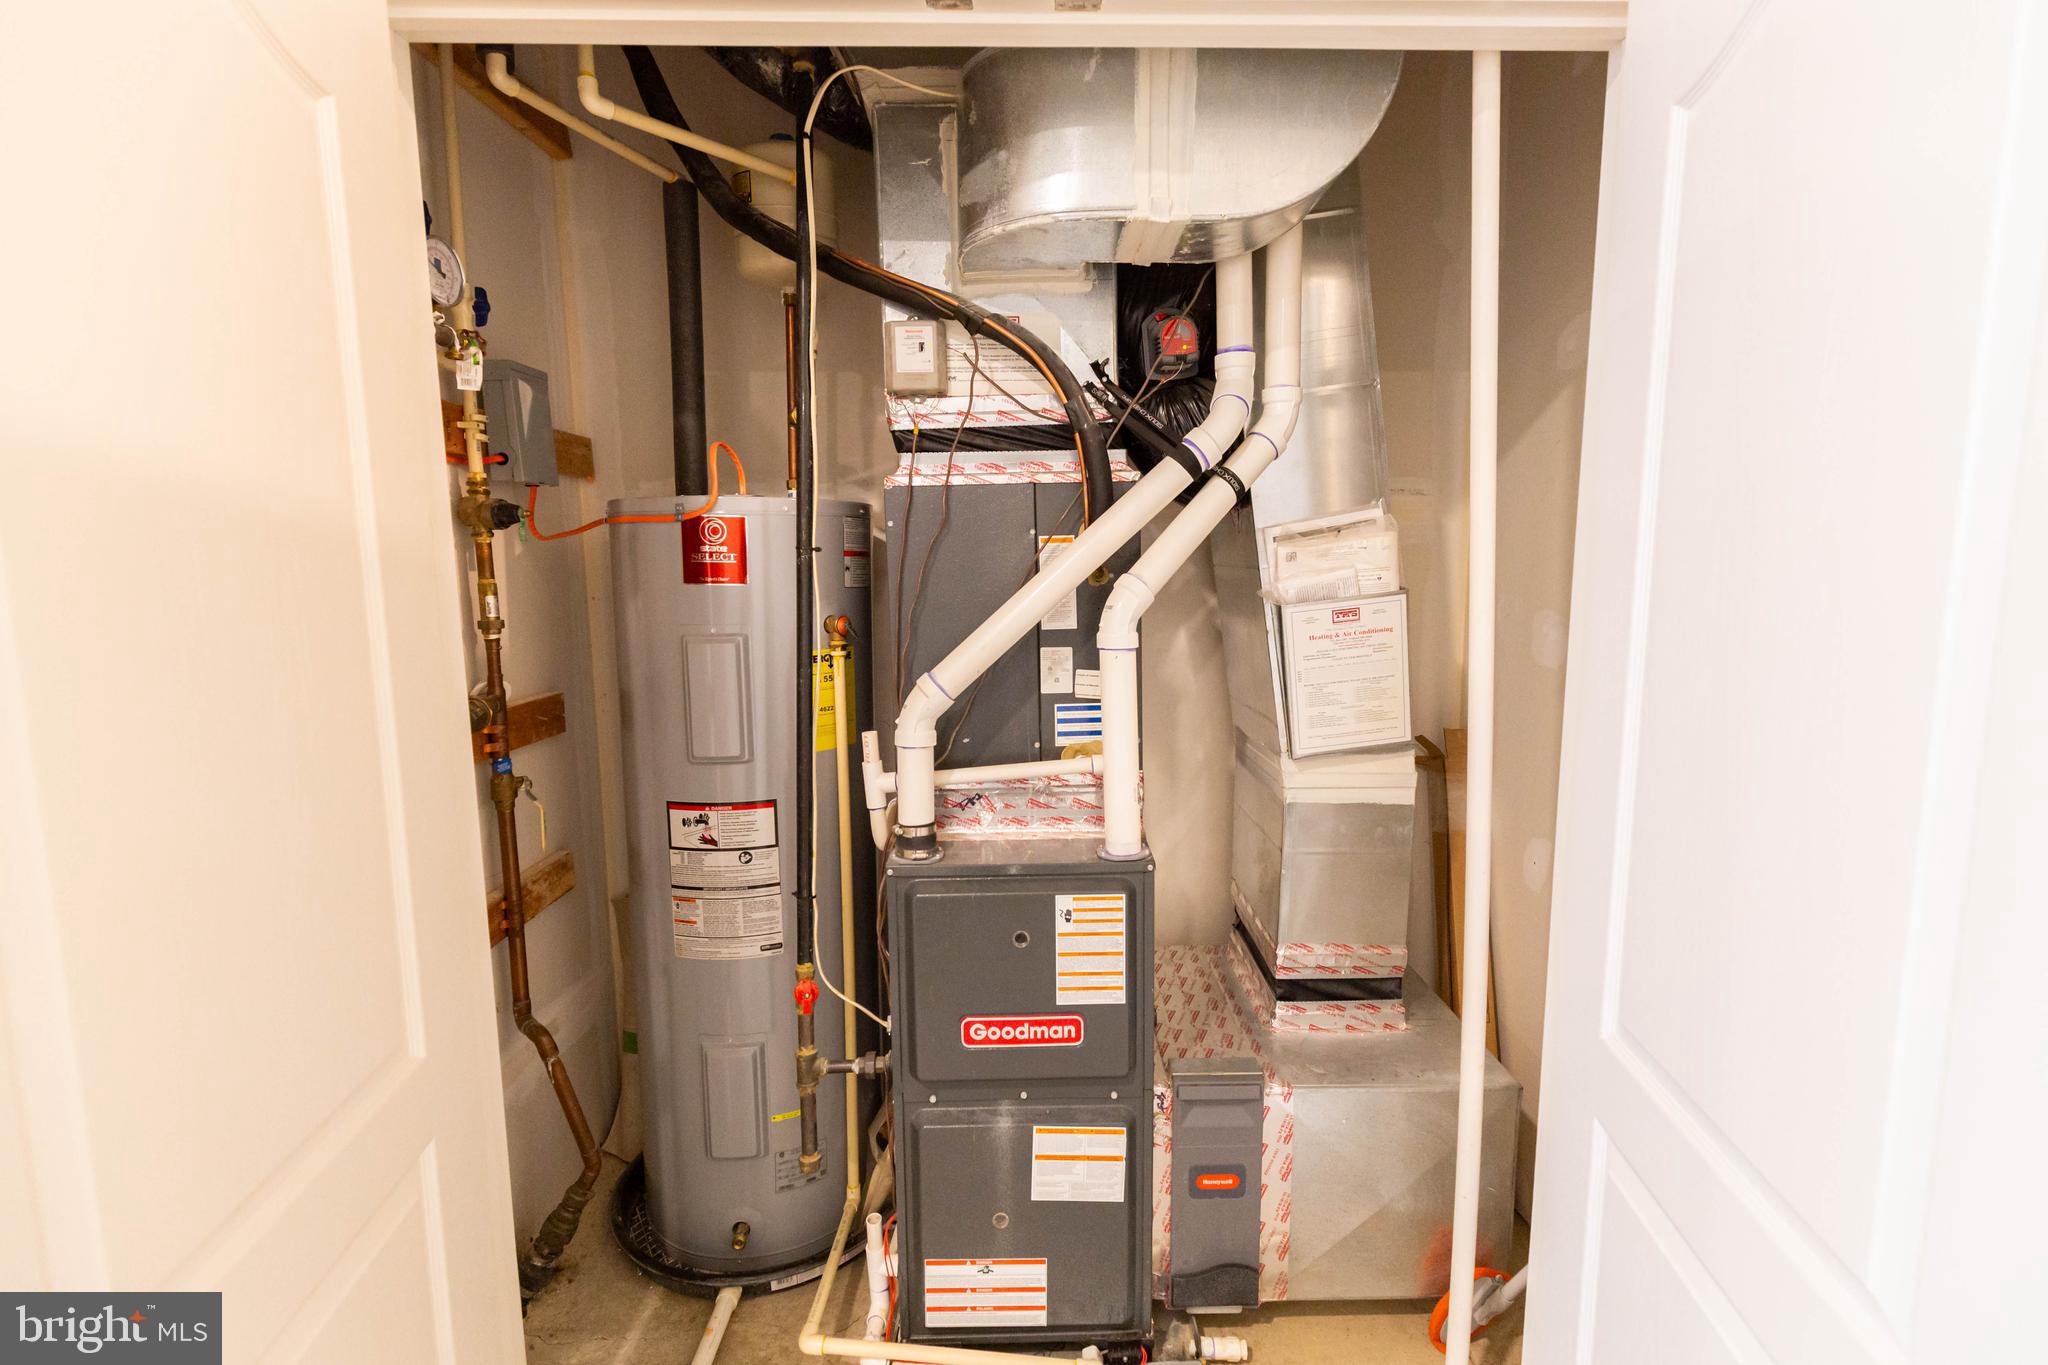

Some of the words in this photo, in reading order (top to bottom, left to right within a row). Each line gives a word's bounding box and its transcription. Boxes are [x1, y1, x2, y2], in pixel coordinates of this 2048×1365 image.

[1223, 472, 1241, 492] SIOUX
[691, 553, 737, 561] SELECT
[1308, 633, 1333, 641] Heating
[1353, 626, 1394, 636] Conditioning
[969, 1022, 1076, 1041] Goodman
[1202, 1178, 1233, 1186] Honeywell
